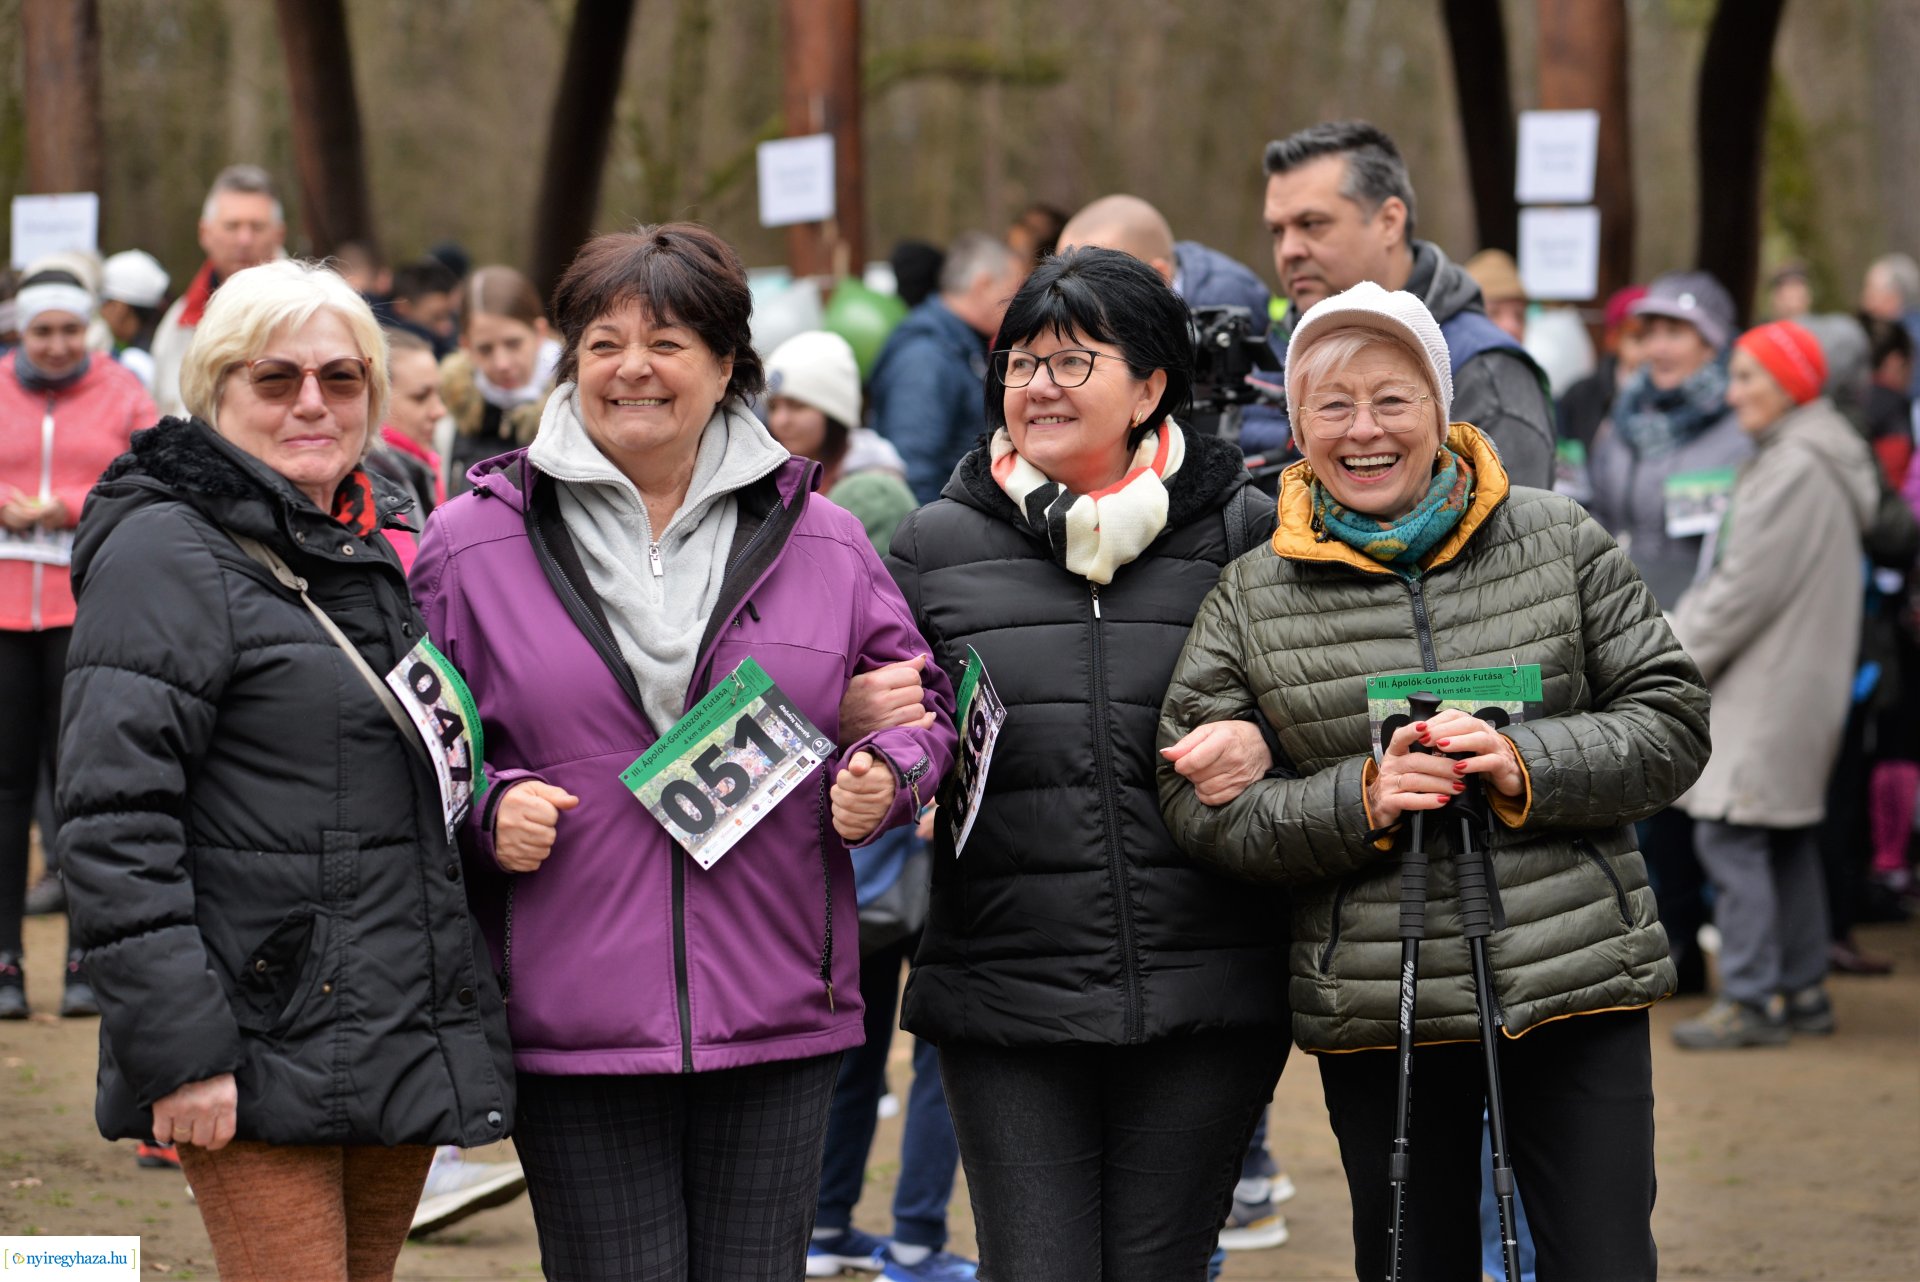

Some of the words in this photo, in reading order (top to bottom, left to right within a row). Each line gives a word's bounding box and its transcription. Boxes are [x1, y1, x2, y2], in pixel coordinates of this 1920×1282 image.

[408, 661, 473, 782] 047
[1378, 679, 1390, 689] III.
[1391, 675, 1472, 689] Ápolók-Gondozók
[1473, 672, 1503, 682] Futása
[1442, 687, 1455, 695] km
[1455, 685, 1471, 694] séta
[631, 768, 644, 778] III.
[642, 710, 704, 767] Ápolók-Gondozók
[702, 687, 729, 713] Futása
[660, 713, 788, 835] 051
[687, 729, 701, 743] km
[698, 719, 712, 735] séta
[951, 697, 987, 829] 046
